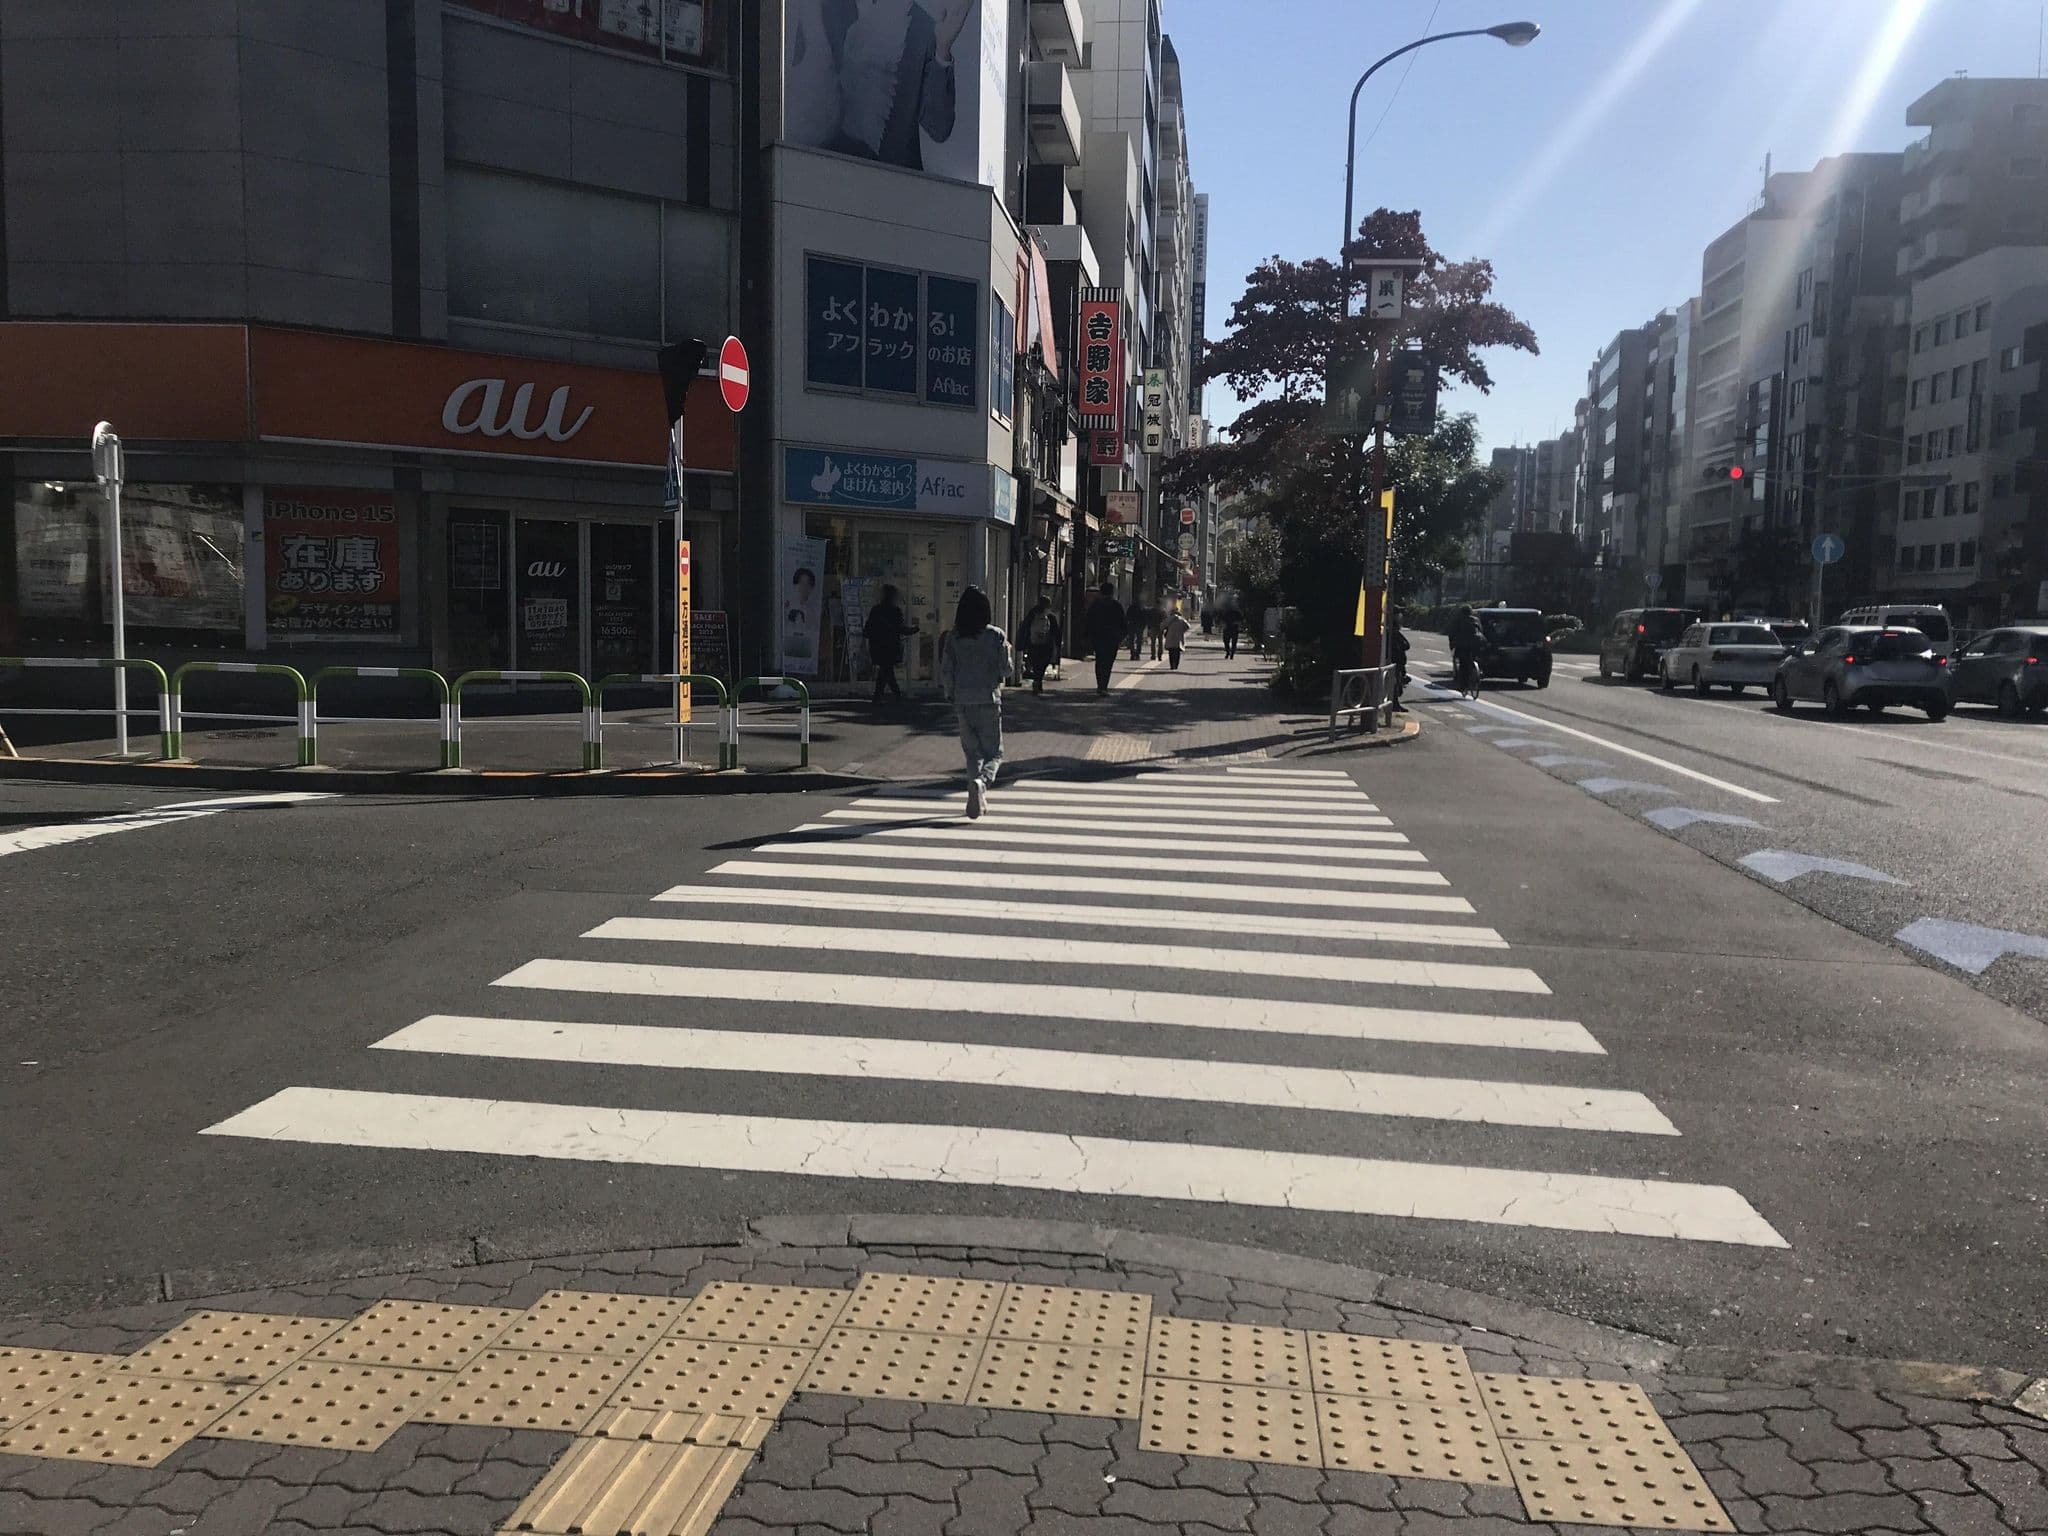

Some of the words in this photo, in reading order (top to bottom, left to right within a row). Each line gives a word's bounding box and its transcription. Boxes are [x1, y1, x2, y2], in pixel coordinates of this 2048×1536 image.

[822, 296, 955, 336] よくわかる!
[827, 332, 971, 366] アフラックのお店
[1085, 311, 1114, 405] 吉野家
[932, 377, 969, 396] Aflac
[442, 377, 595, 442] au
[843, 462, 897, 478] よくわかる!
[843, 480, 904, 496] ほけん案内
[920, 476, 967, 498] Aflac
[264, 500, 358, 521] iPhone
[362, 504, 396, 522] 15
[280, 533, 381, 571] 在庫
[527, 560, 567, 577] au
[277, 570, 385, 594] あります
